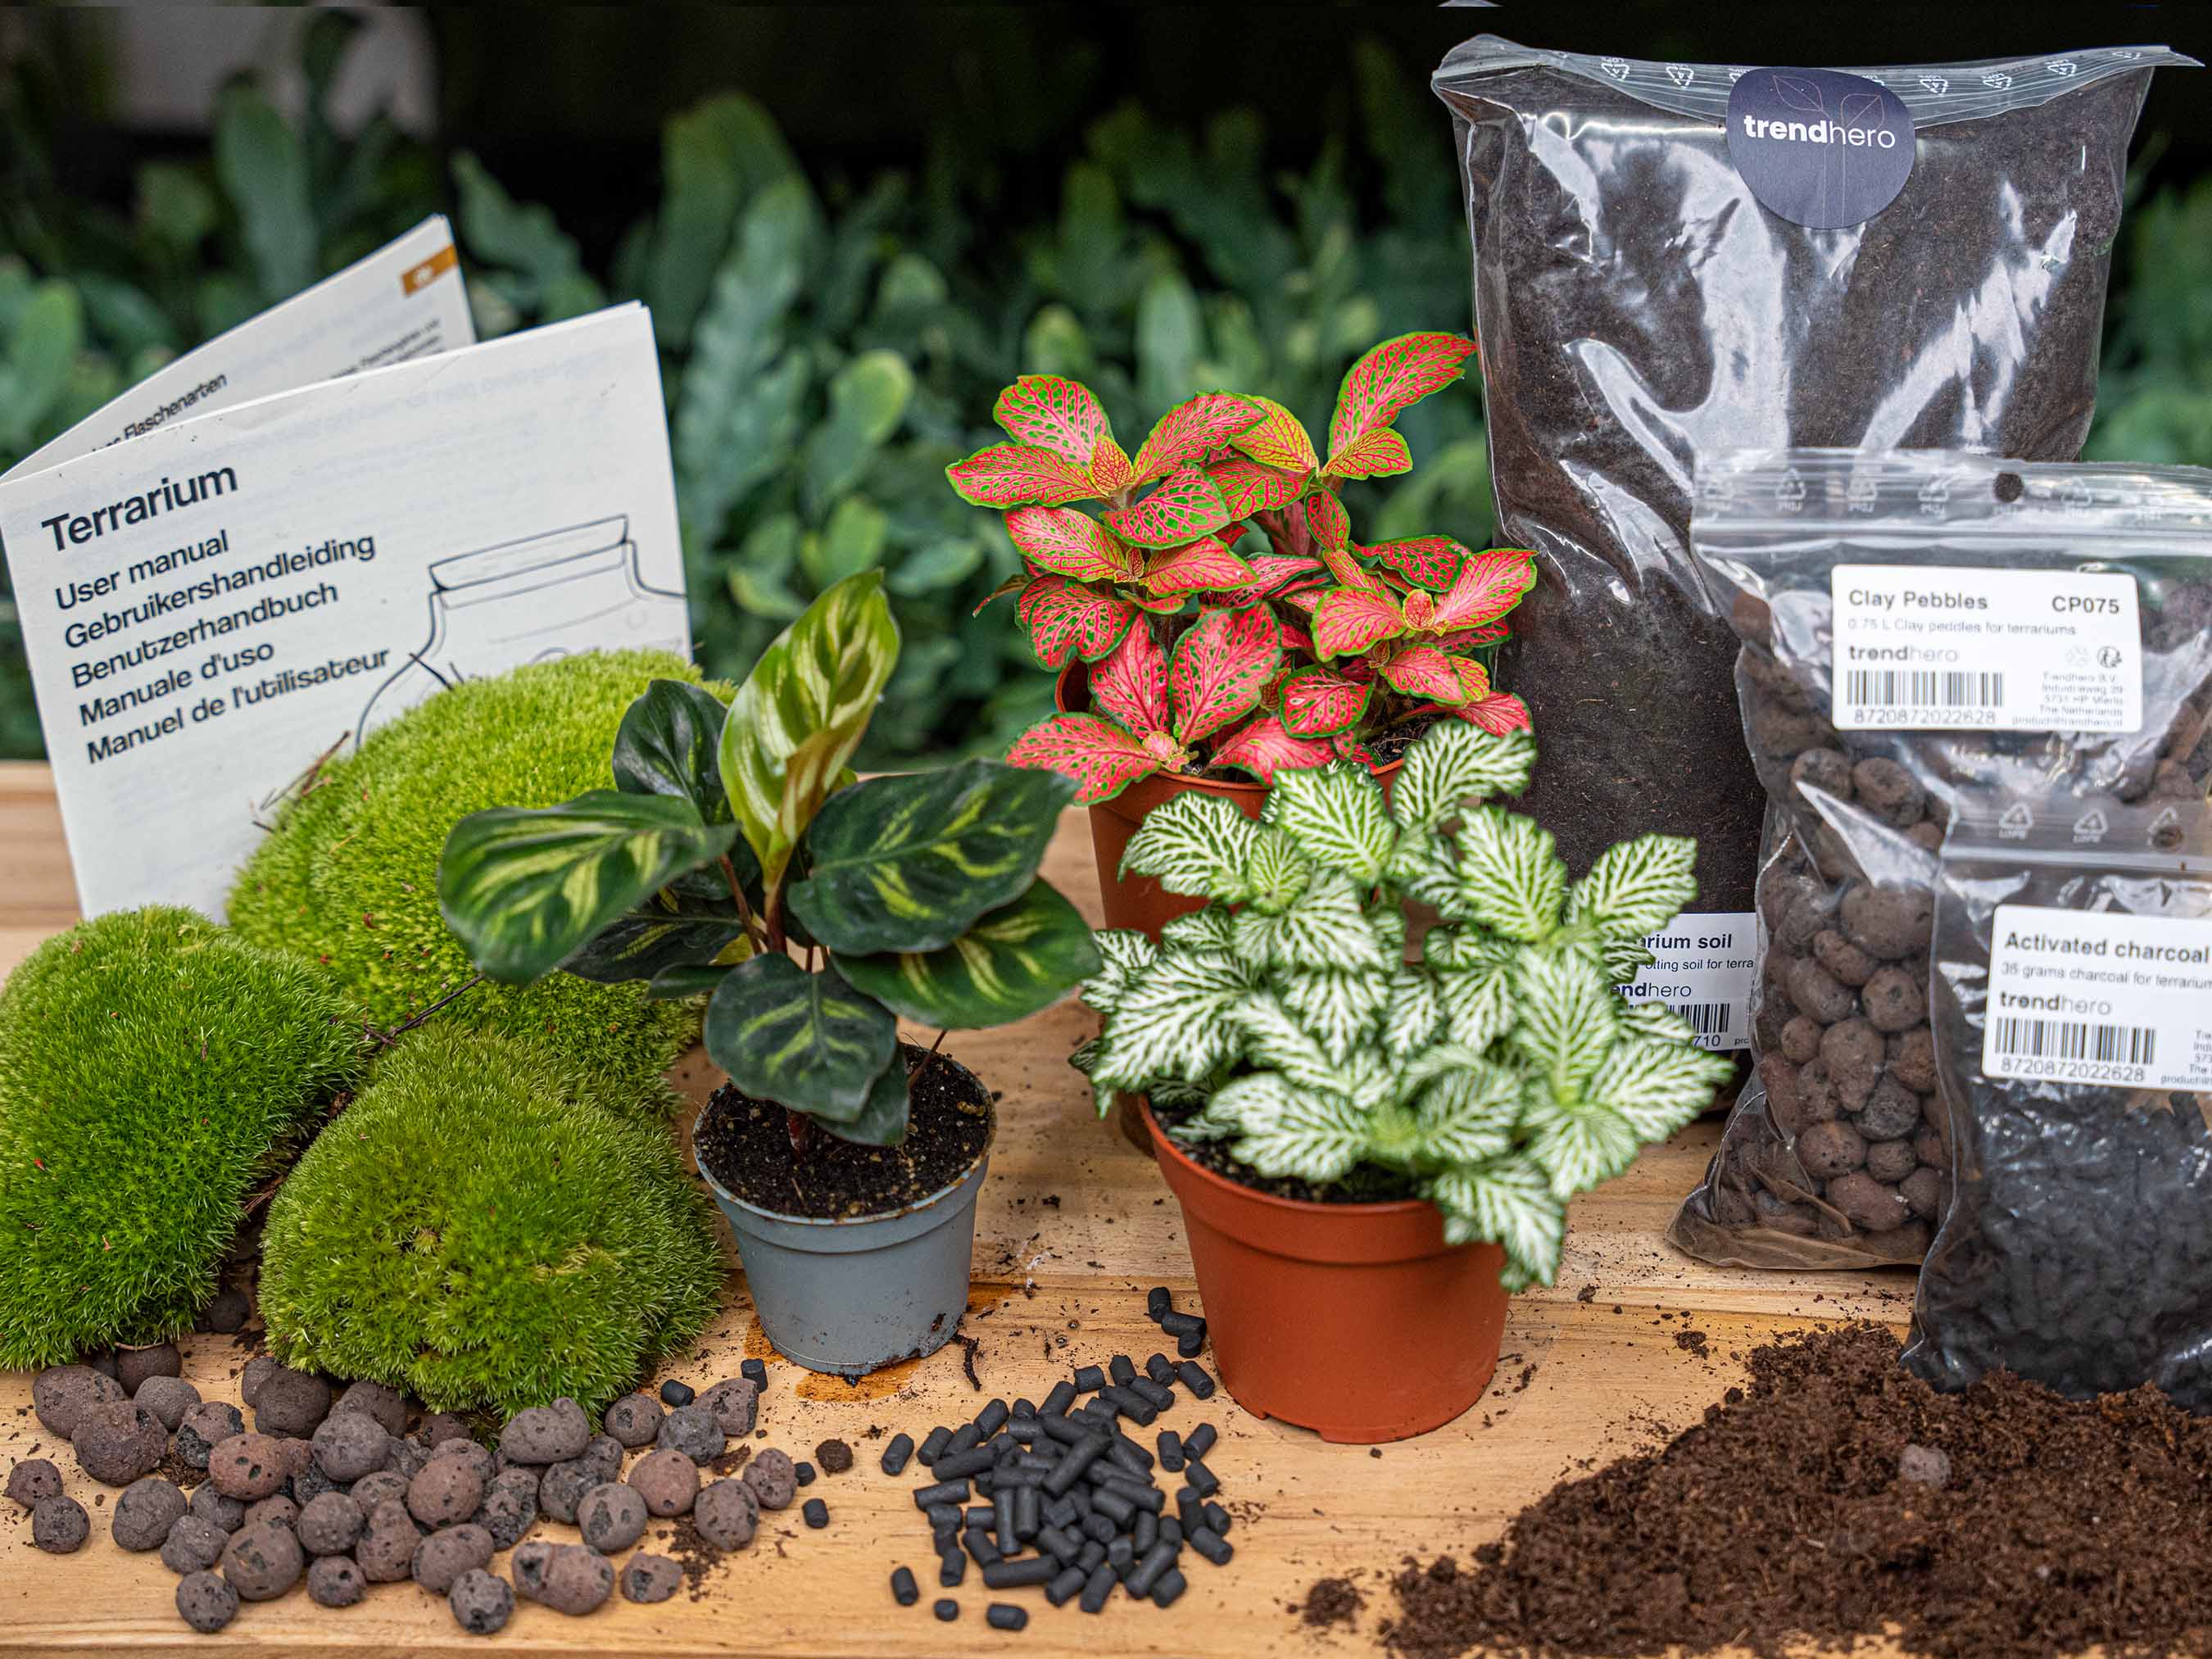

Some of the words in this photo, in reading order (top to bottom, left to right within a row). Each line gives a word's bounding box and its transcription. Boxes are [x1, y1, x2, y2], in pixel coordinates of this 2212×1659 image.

[1743, 115, 1896, 148] trendhero
[124, 374, 228, 440] Flaschenarten
[41, 465, 238, 552] Terrarium
[55, 572, 120, 611] User
[128, 529, 229, 580] manual
[65, 536, 376, 649] Gebruikershandleiding
[1848, 589, 1896, 610] Clay
[1903, 591, 1989, 610] Pebbles
[2051, 596, 2120, 614] CP075
[71, 582, 339, 689] Benutzerhandbuch
[1894, 618, 1924, 632] Clay
[1986, 620, 2004, 633] for
[1848, 645, 1960, 663] trendhero
[79, 669, 193, 728] Manuale
[201, 642, 274, 679] d'uso
[87, 707, 186, 764] Manuel
[192, 693, 225, 723] de
[233, 649, 390, 709] l'utilisateur
[1641, 933, 1690, 949] rium
[1698, 933, 1732, 949] soil
[2005, 931, 2109, 956] Activated
[2114, 941, 2210, 964] charcoal
[1683, 959, 1703, 970] soil
[1707, 959, 1723, 970] for
[1726, 958, 1754, 969] terra
[2022, 965, 2065, 980] grams
[2069, 968, 2128, 983] charcoal
[2133, 972, 2152, 986] for
[1611, 982, 1692, 997] endhero
[2000, 991, 2112, 1015] trendhero
[1693, 1035, 1721, 1048] 710
[2001, 1056, 2146, 1083] 8720872022628
